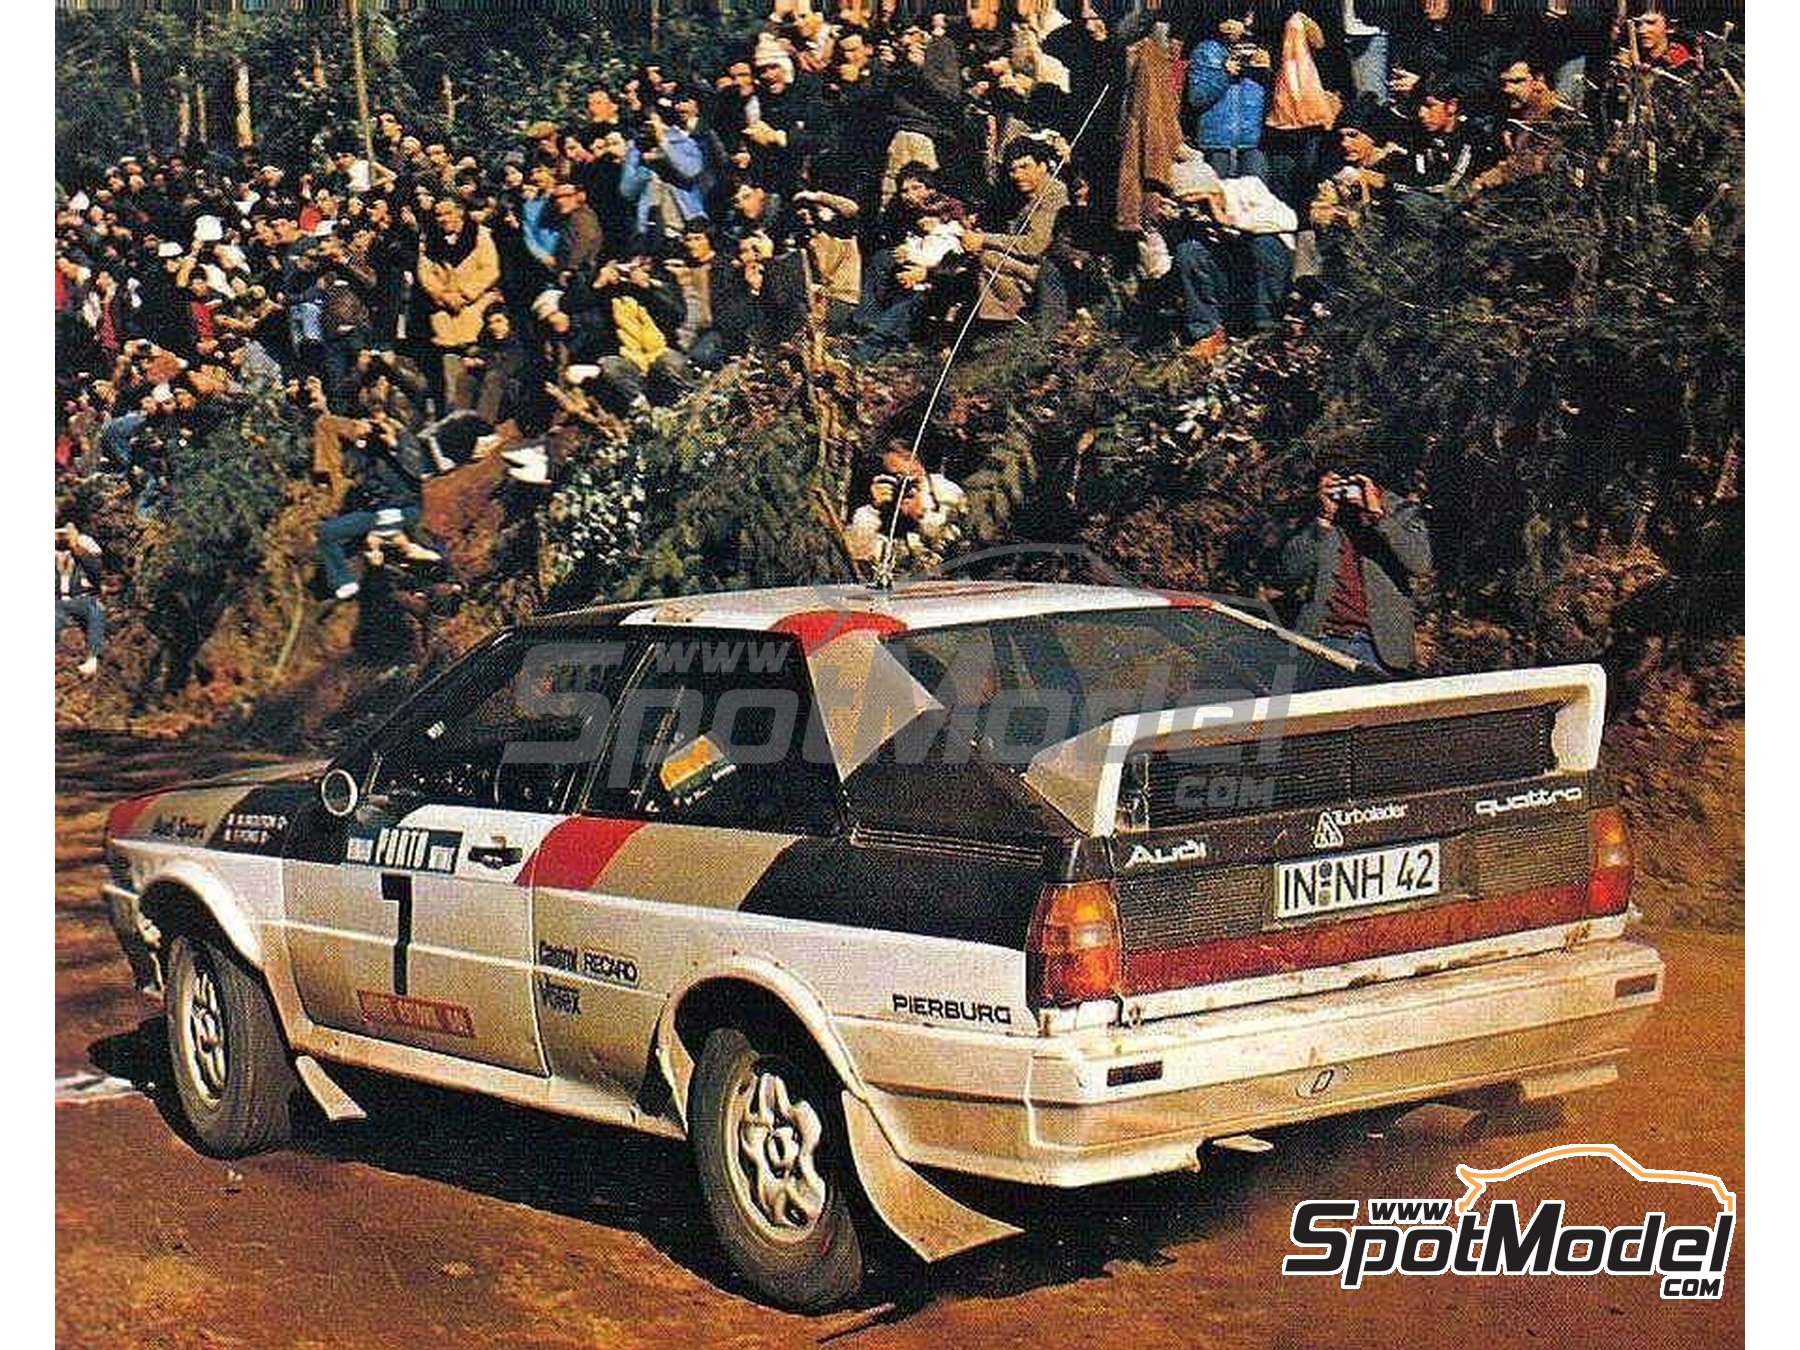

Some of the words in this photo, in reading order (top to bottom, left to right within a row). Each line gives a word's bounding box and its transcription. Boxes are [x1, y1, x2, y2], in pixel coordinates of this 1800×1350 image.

[1475, 786, 1582, 816] quattro
[1123, 840, 1207, 869] Audi
[1396, 849, 1434, 890] 42
[380, 872, 412, 995] 7
[892, 994, 1012, 1024] PIERBURG
